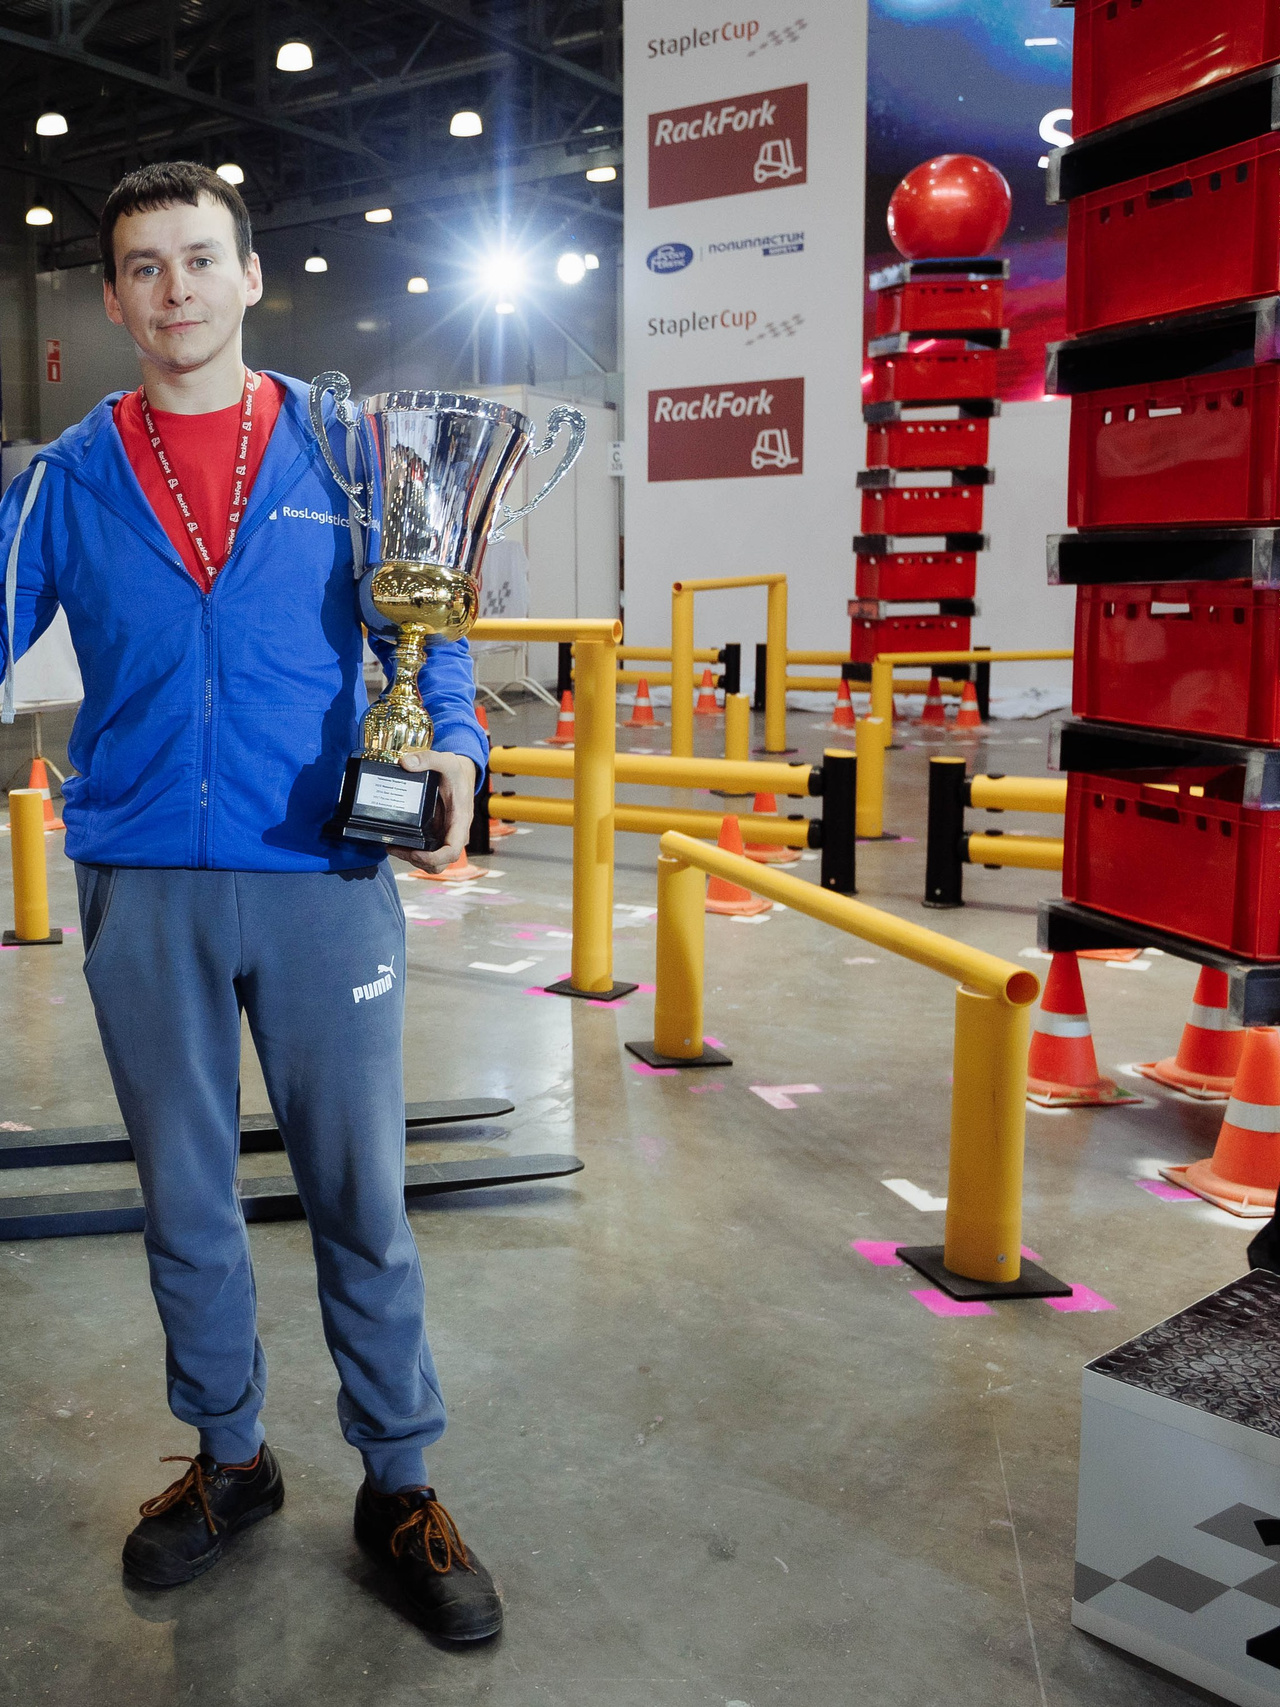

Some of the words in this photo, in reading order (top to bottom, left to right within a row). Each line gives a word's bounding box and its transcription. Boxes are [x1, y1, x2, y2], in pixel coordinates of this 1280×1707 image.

[648, 20, 760, 59] StaplerCup
[654, 99, 777, 147] RackFork
[648, 310, 757, 338] StaplerCup
[654, 388, 774, 423] RackFork
[352, 973, 393, 1004] PUMA
